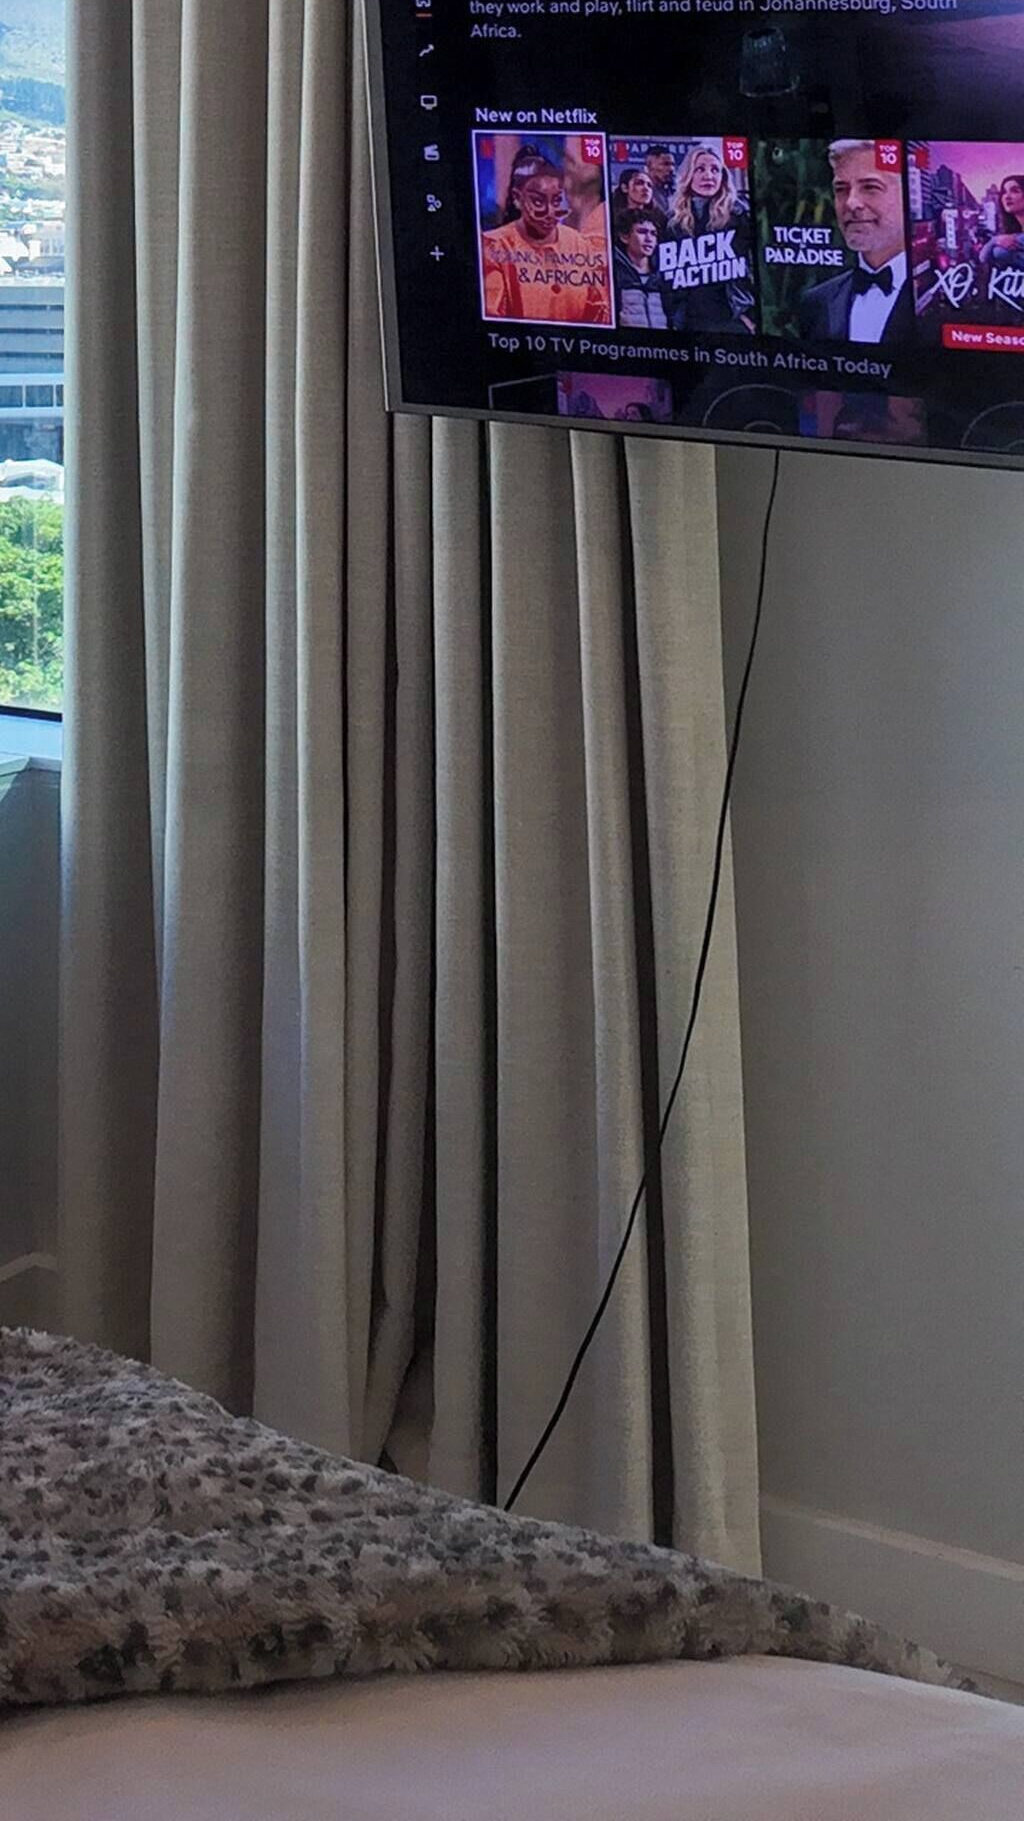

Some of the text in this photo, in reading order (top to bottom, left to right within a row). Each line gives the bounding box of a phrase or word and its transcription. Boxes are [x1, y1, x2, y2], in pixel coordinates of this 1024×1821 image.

[469, 0, 504, 17] they
[470, 22, 523, 39] Africa.
[475, 108, 598, 124] New on Netflix
[585, 146, 601, 159] 10
[728, 149, 744, 161] 10
[880, 153, 898, 165] 10
[773, 226, 832, 244] TICKET
[544, 249, 605, 268] FAMOUS
[659, 229, 736, 272] BACK
[765, 246, 844, 267] PARADISE
[518, 267, 606, 288] & AFRICAN
[672, 256, 746, 290] ACTION
[951, 330, 983, 343] New
[487, 332, 892, 379] Top 10 TV Programmes in South Africa Today
